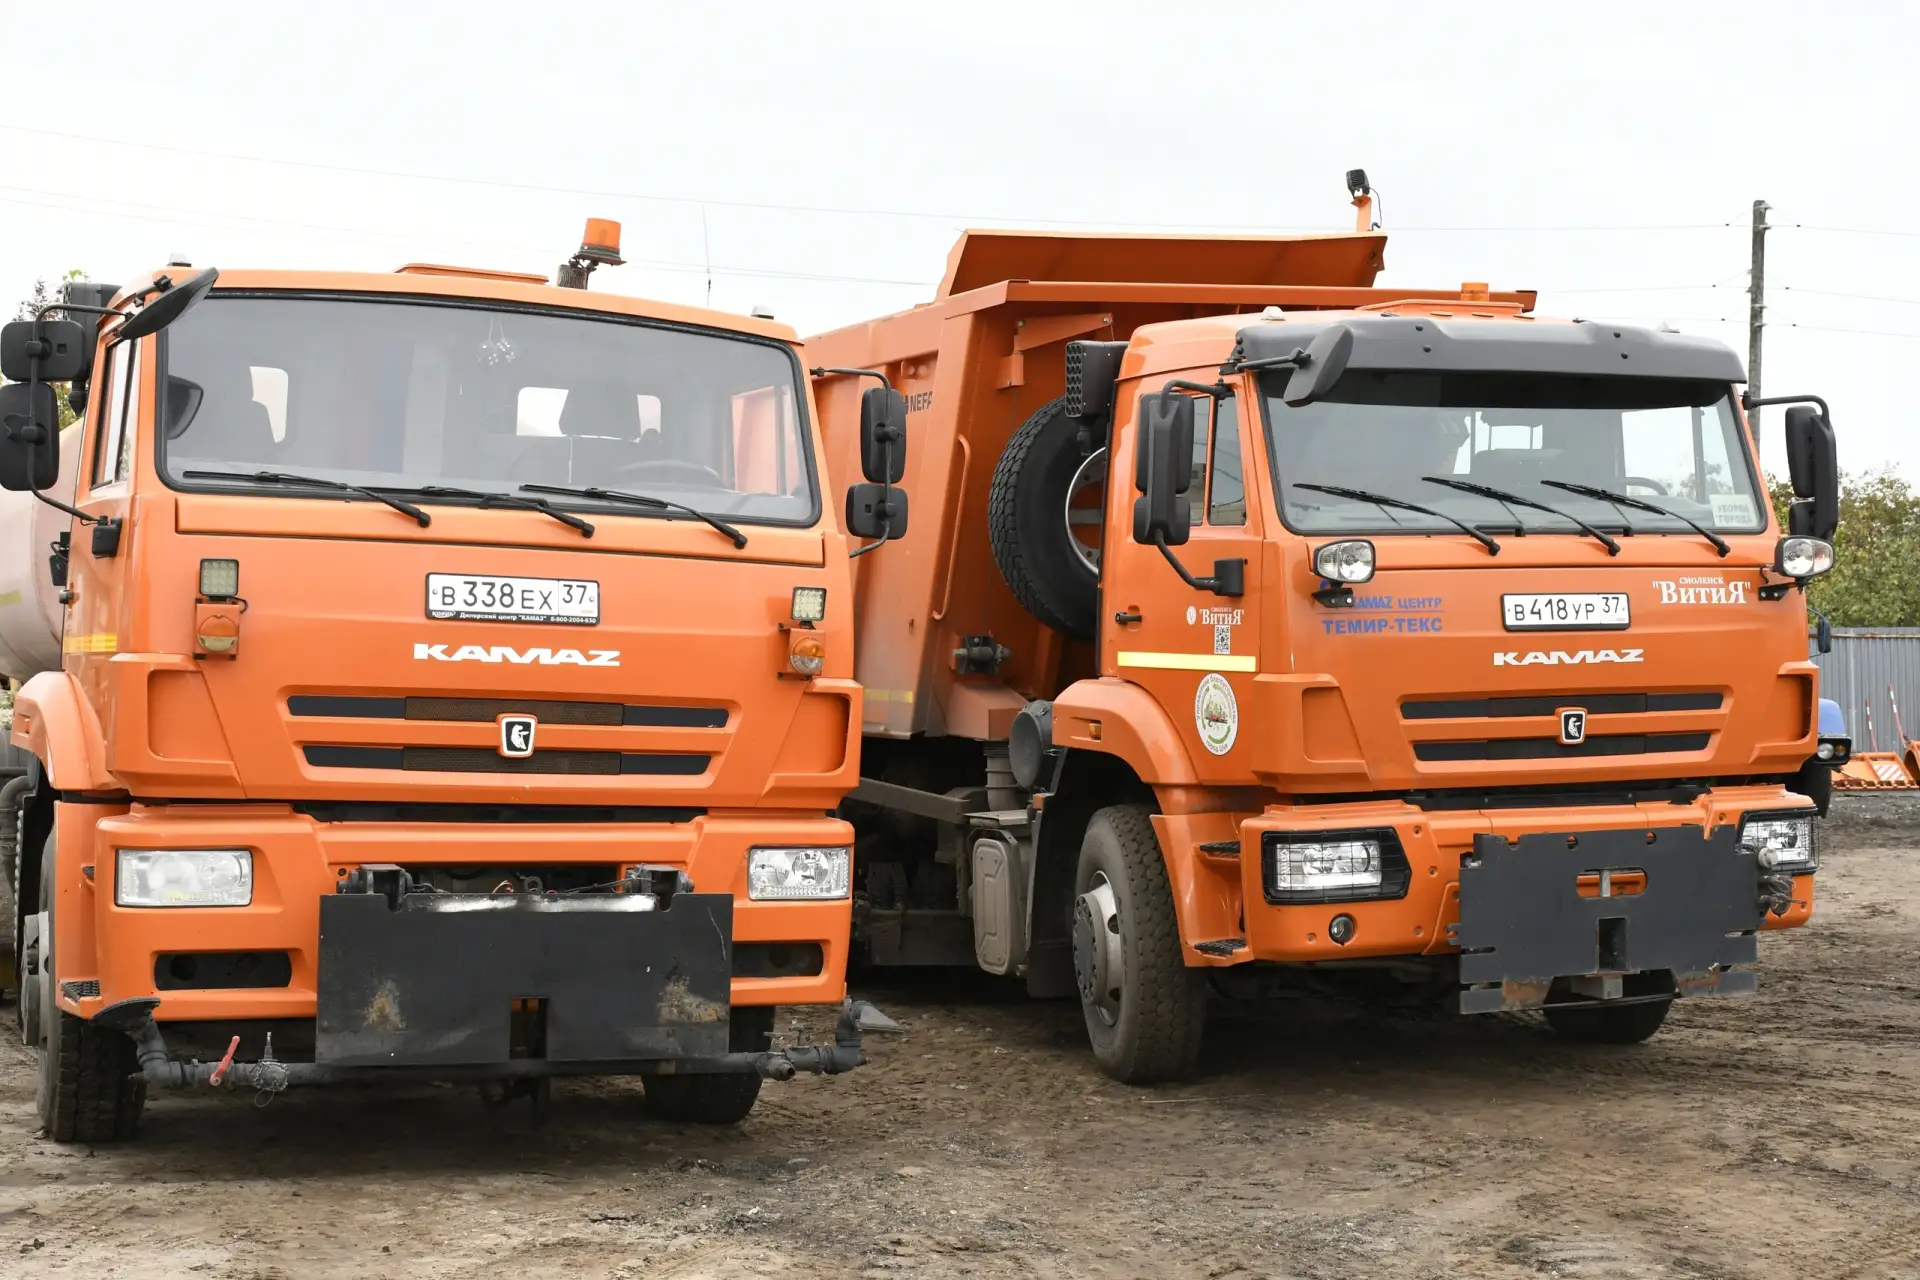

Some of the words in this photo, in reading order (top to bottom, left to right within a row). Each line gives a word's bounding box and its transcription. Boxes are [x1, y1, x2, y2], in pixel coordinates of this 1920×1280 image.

[1679, 577, 1724, 585] СМОЛЕНСК
[1353, 596, 1393, 609] AMAZ
[1398, 597, 1442, 610] ЦЕНТР
[460, 612, 497, 620] Дилерский
[518, 614, 547, 622] "КАМАЗ"
[1322, 617, 1443, 634] ТЕМИР-ТЕКС
[413, 643, 621, 667] KAMAZ
[1493, 648, 1644, 666] KAMAZ
